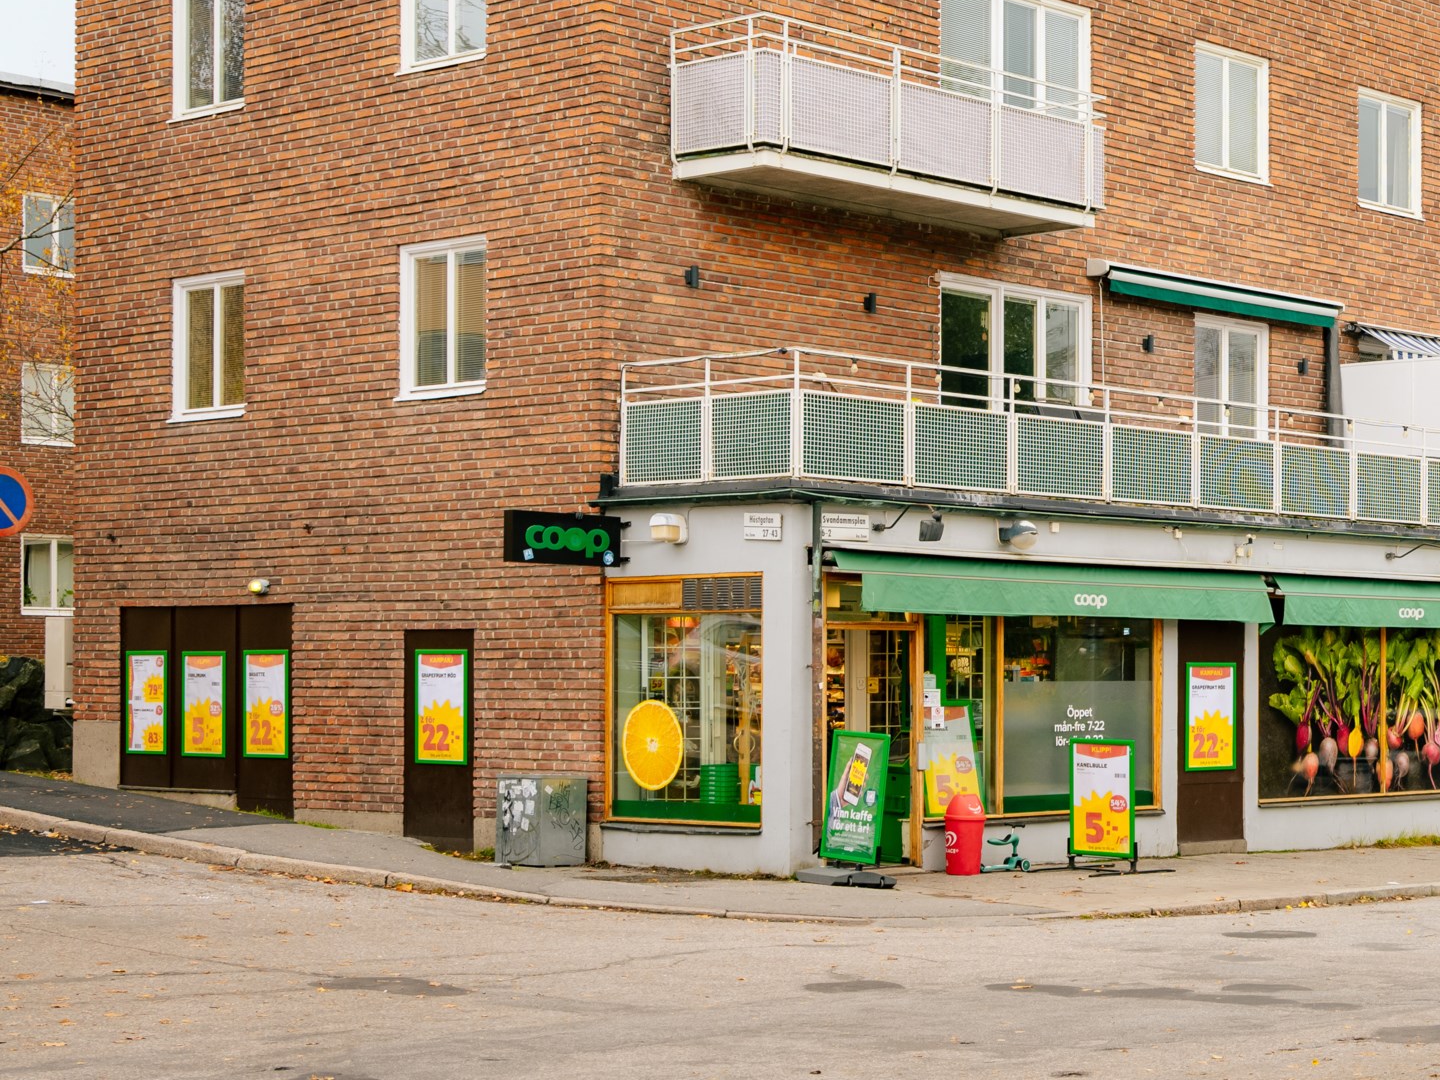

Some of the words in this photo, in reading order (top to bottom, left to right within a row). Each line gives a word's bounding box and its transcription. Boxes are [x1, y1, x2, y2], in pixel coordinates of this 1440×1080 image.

[822, 515, 866, 526] Svandammsplan
[525, 524, 610, 558] coop
[1074, 593, 1107, 609] coop
[1398, 607, 1424, 620] coop
[1066, 705, 1093, 719] Öppet
[1054, 720, 1086, 732] mån-fre
[1087, 720, 1105, 731] 7-22
[1193, 732, 1229, 759] 22:-
[832, 806, 849, 819] Vinn
[850, 809, 872, 822] kaffe
[832, 820, 845, 830] för
[845, 823, 856, 832] ett
[858, 823, 870, 834] år!
[1085, 812, 1118, 844] 5:-
